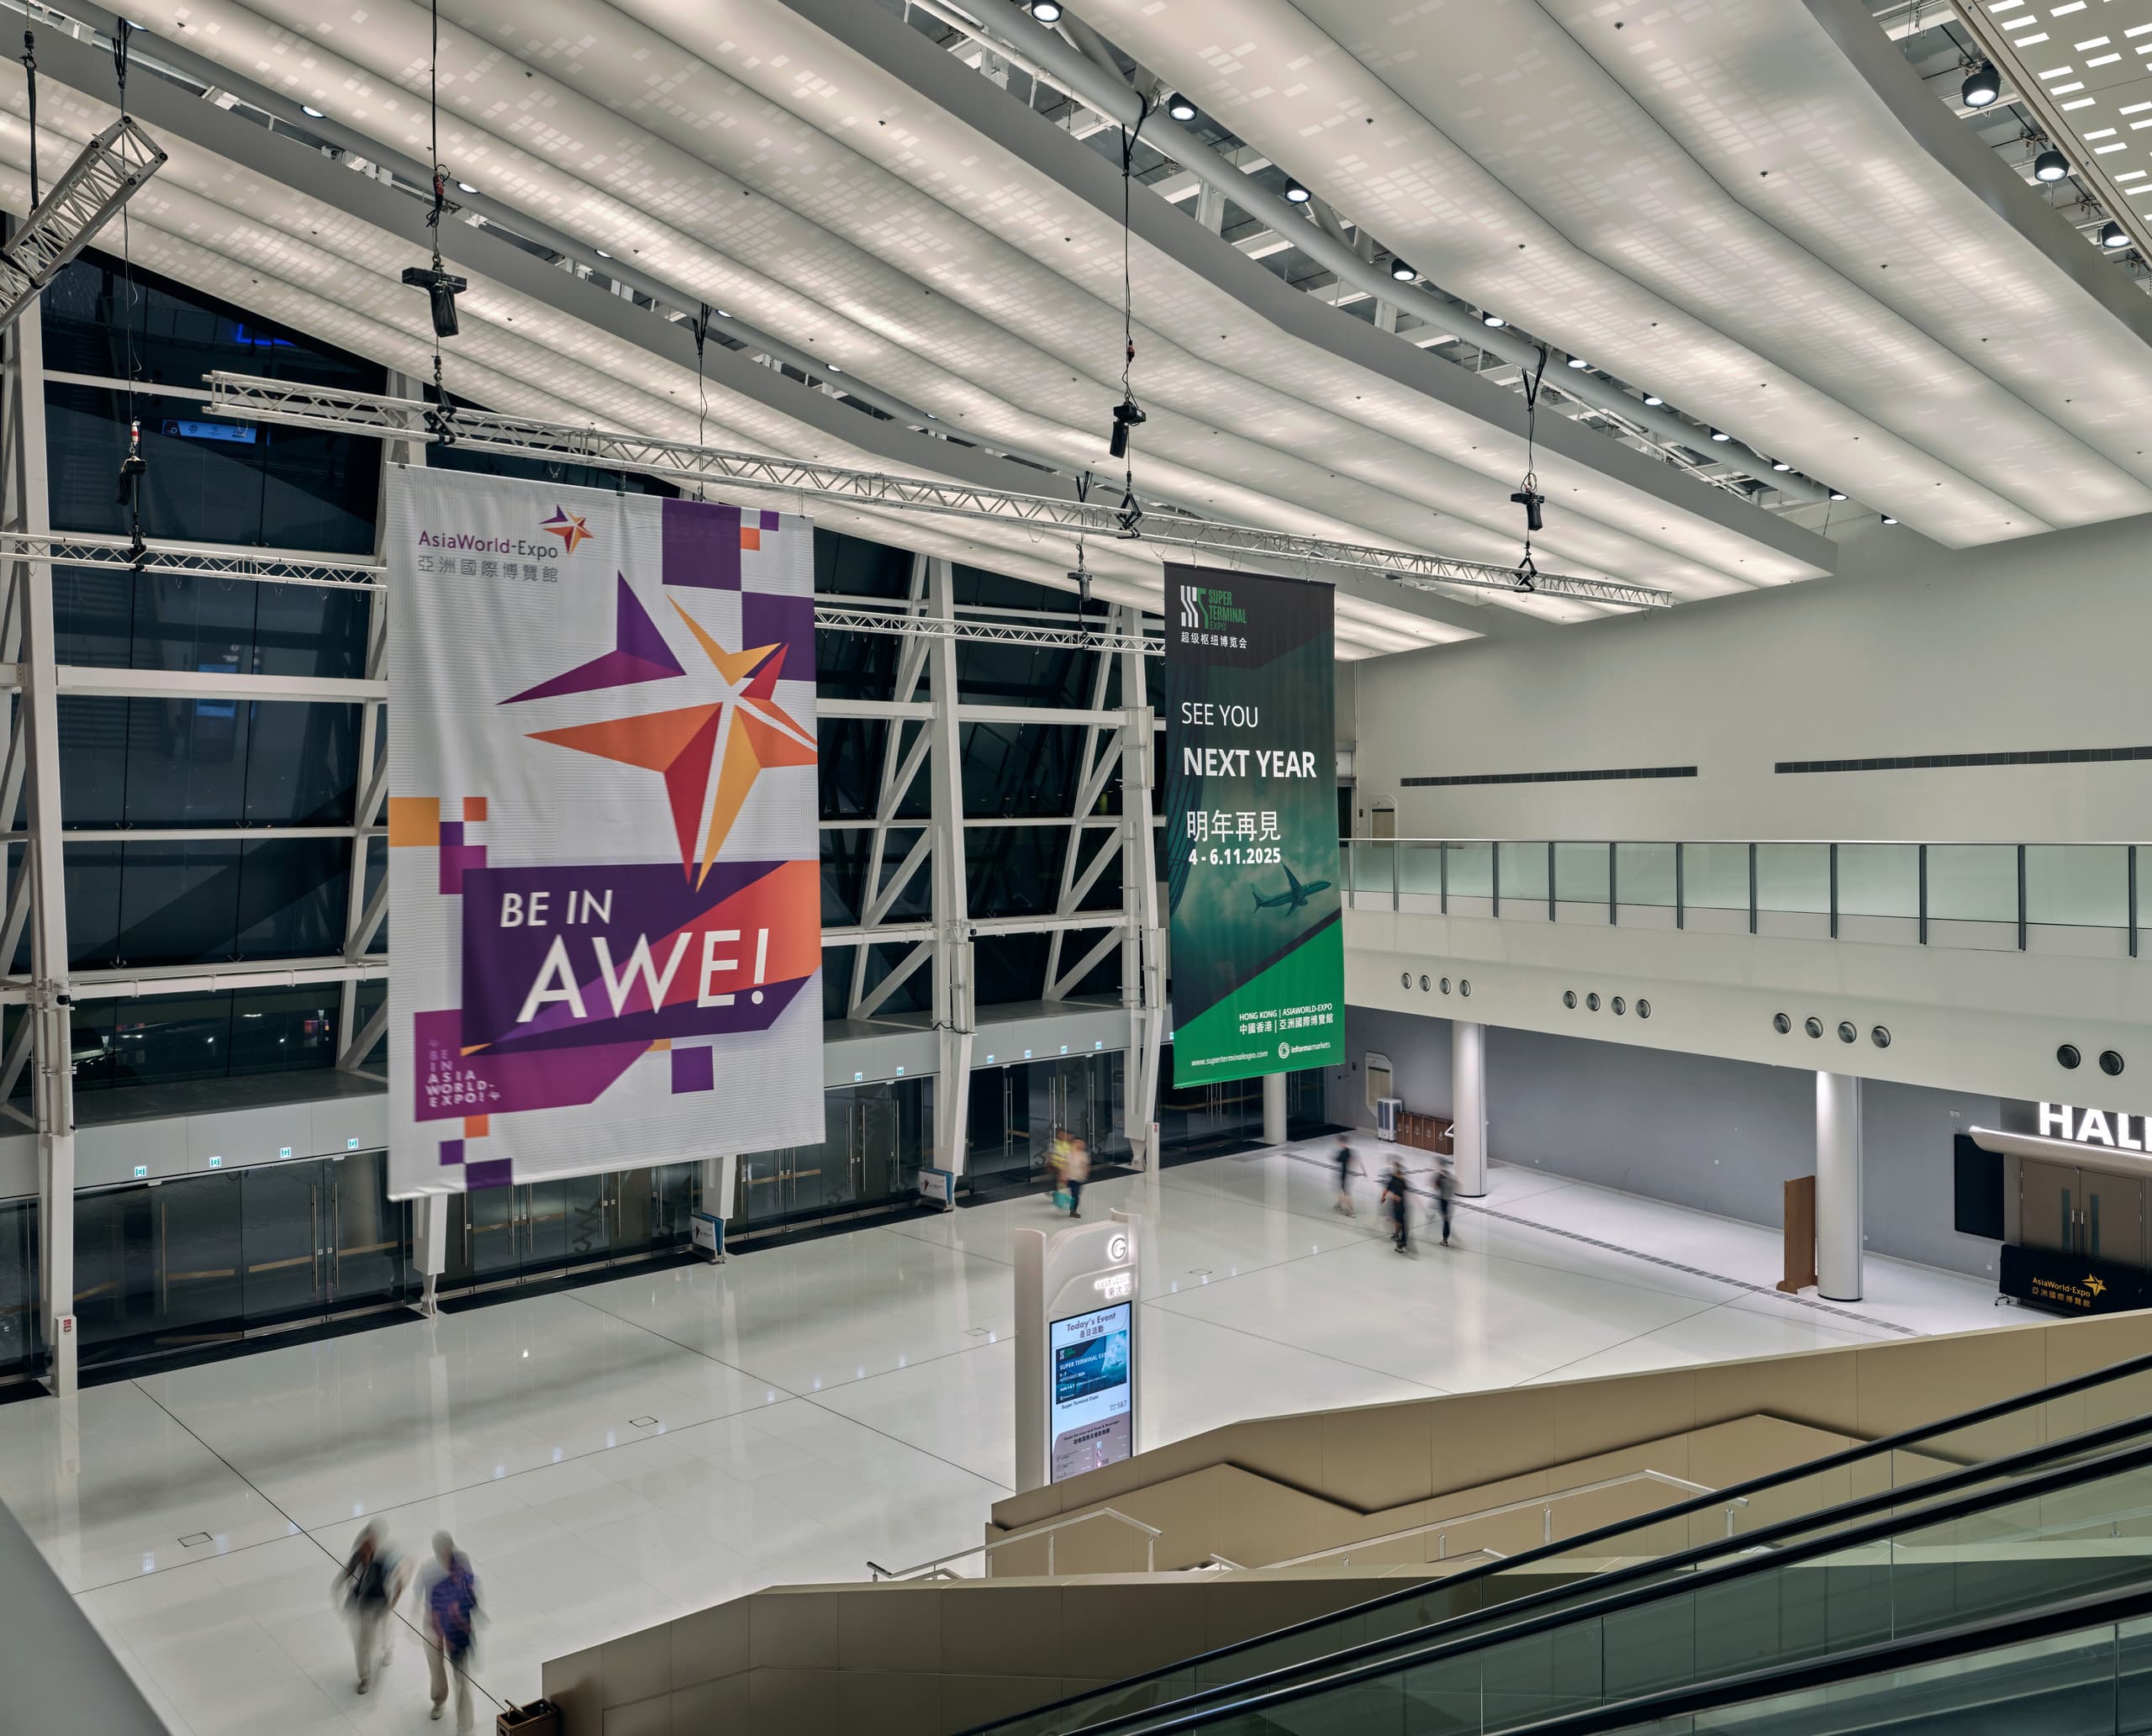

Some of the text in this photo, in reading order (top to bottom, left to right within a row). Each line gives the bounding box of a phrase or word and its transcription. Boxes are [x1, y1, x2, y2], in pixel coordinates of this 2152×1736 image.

[418, 530, 558, 561] AsiaWorld-Expo
[418, 555, 558, 583] 亞洲國際博覽館
[1208, 589, 1232, 605] SUPER
[1209, 605, 1247, 624] TERMINAL
[1210, 621, 1227, 631] EXPO
[1181, 631, 1247, 649] 超级枢纽博览会
[1181, 702, 1258, 727] SEE YOU
[1184, 747, 1317, 778] NEXT YEAR
[1187, 810, 1281, 842] 明年再見
[1189, 849, 1198, 865] 4
[1210, 847, 1281, 865] 6.11.2025
[500, 889, 613, 928] BE IN
[516, 928, 769, 1023] AWE!
[1239, 1003, 1332, 1021] HONG KONG ASIAWORLD-EXPO
[1239, 1021, 1273, 1035] 中國香港
[429, 1049, 450, 1061] BE
[430, 1060, 453, 1072] IN
[427, 1069, 477, 1084] ASIA
[425, 1080, 495, 1095] WORLD-
[429, 1092, 485, 1107] EXPO!
[1110, 1237, 1126, 1259] G
[2033, 1277, 2091, 1297] AsiaWorld-Expo
[1067, 1312, 1116, 1332] Today's Event
[1059, 1361, 1074, 1371] SUPER
[1075, 1354, 1098, 1366] TERMINAL
[1073, 1397, 1089, 1406] Terminal
